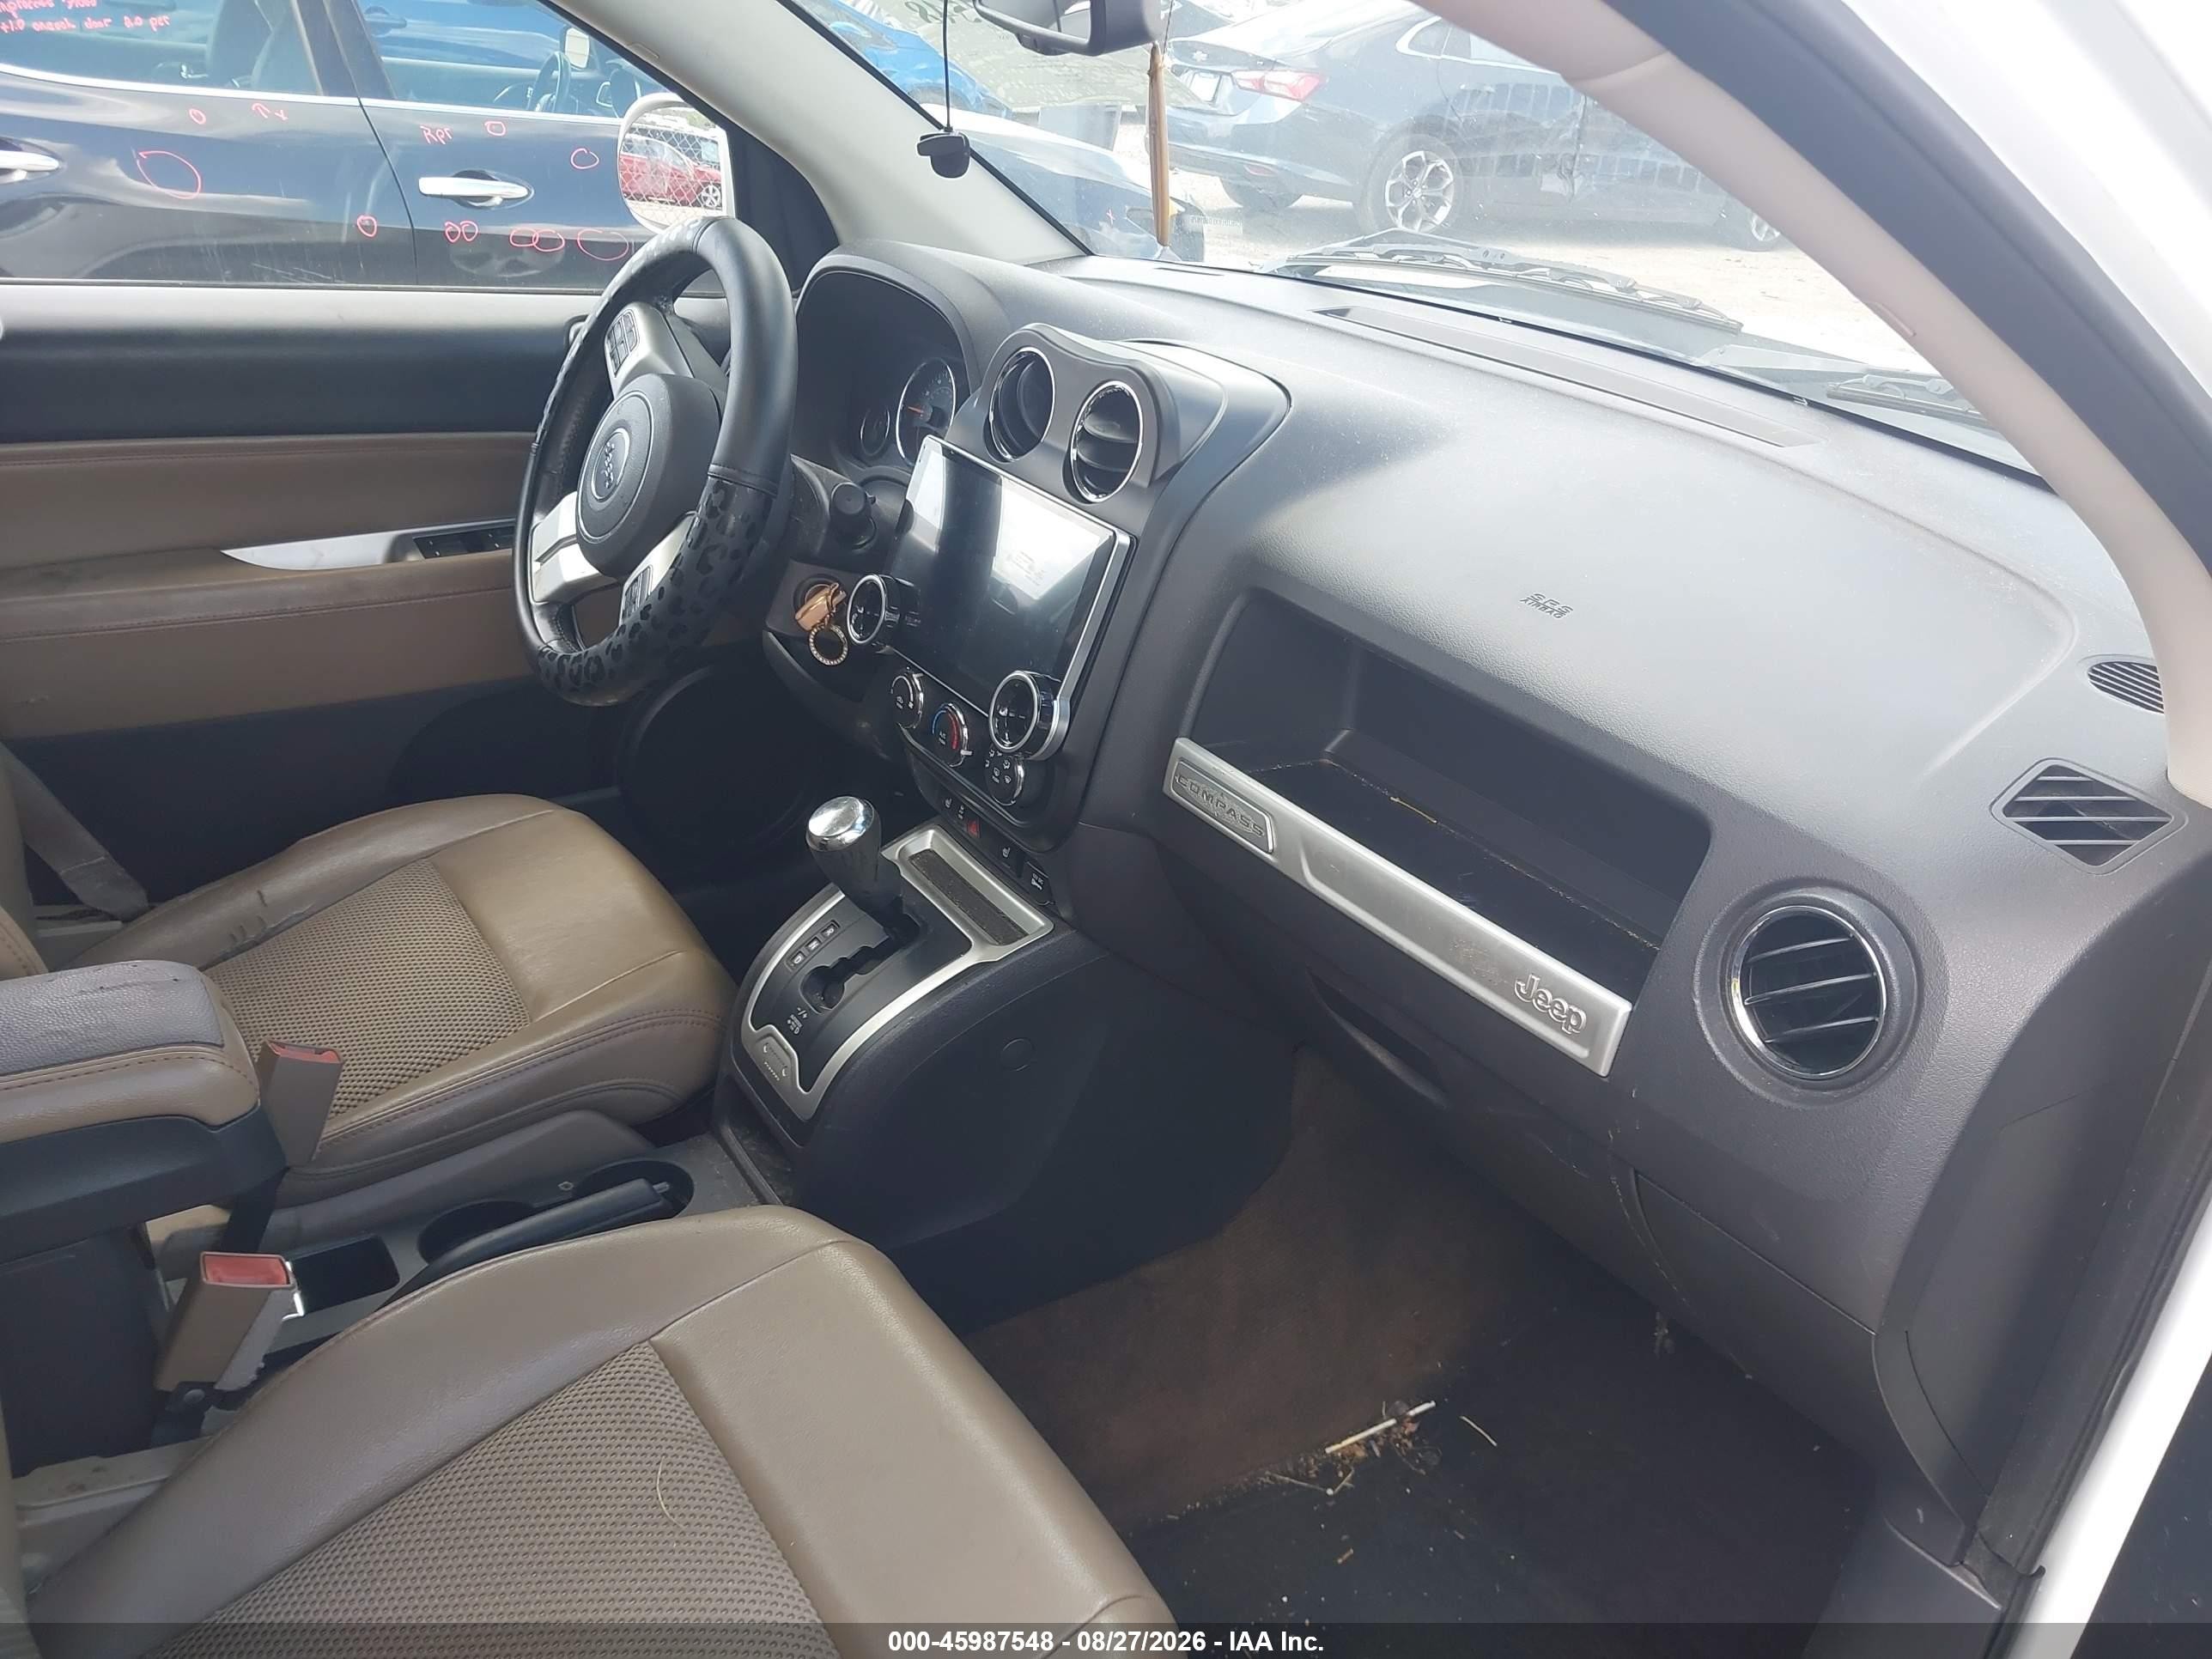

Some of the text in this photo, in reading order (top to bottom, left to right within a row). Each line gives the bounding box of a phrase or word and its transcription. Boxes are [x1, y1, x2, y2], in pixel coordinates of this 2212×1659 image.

[1518, 599, 1565, 619] AIRBAG
[1175, 775, 1266, 839] COMPASS
[1514, 973, 1587, 1035] Jeep
